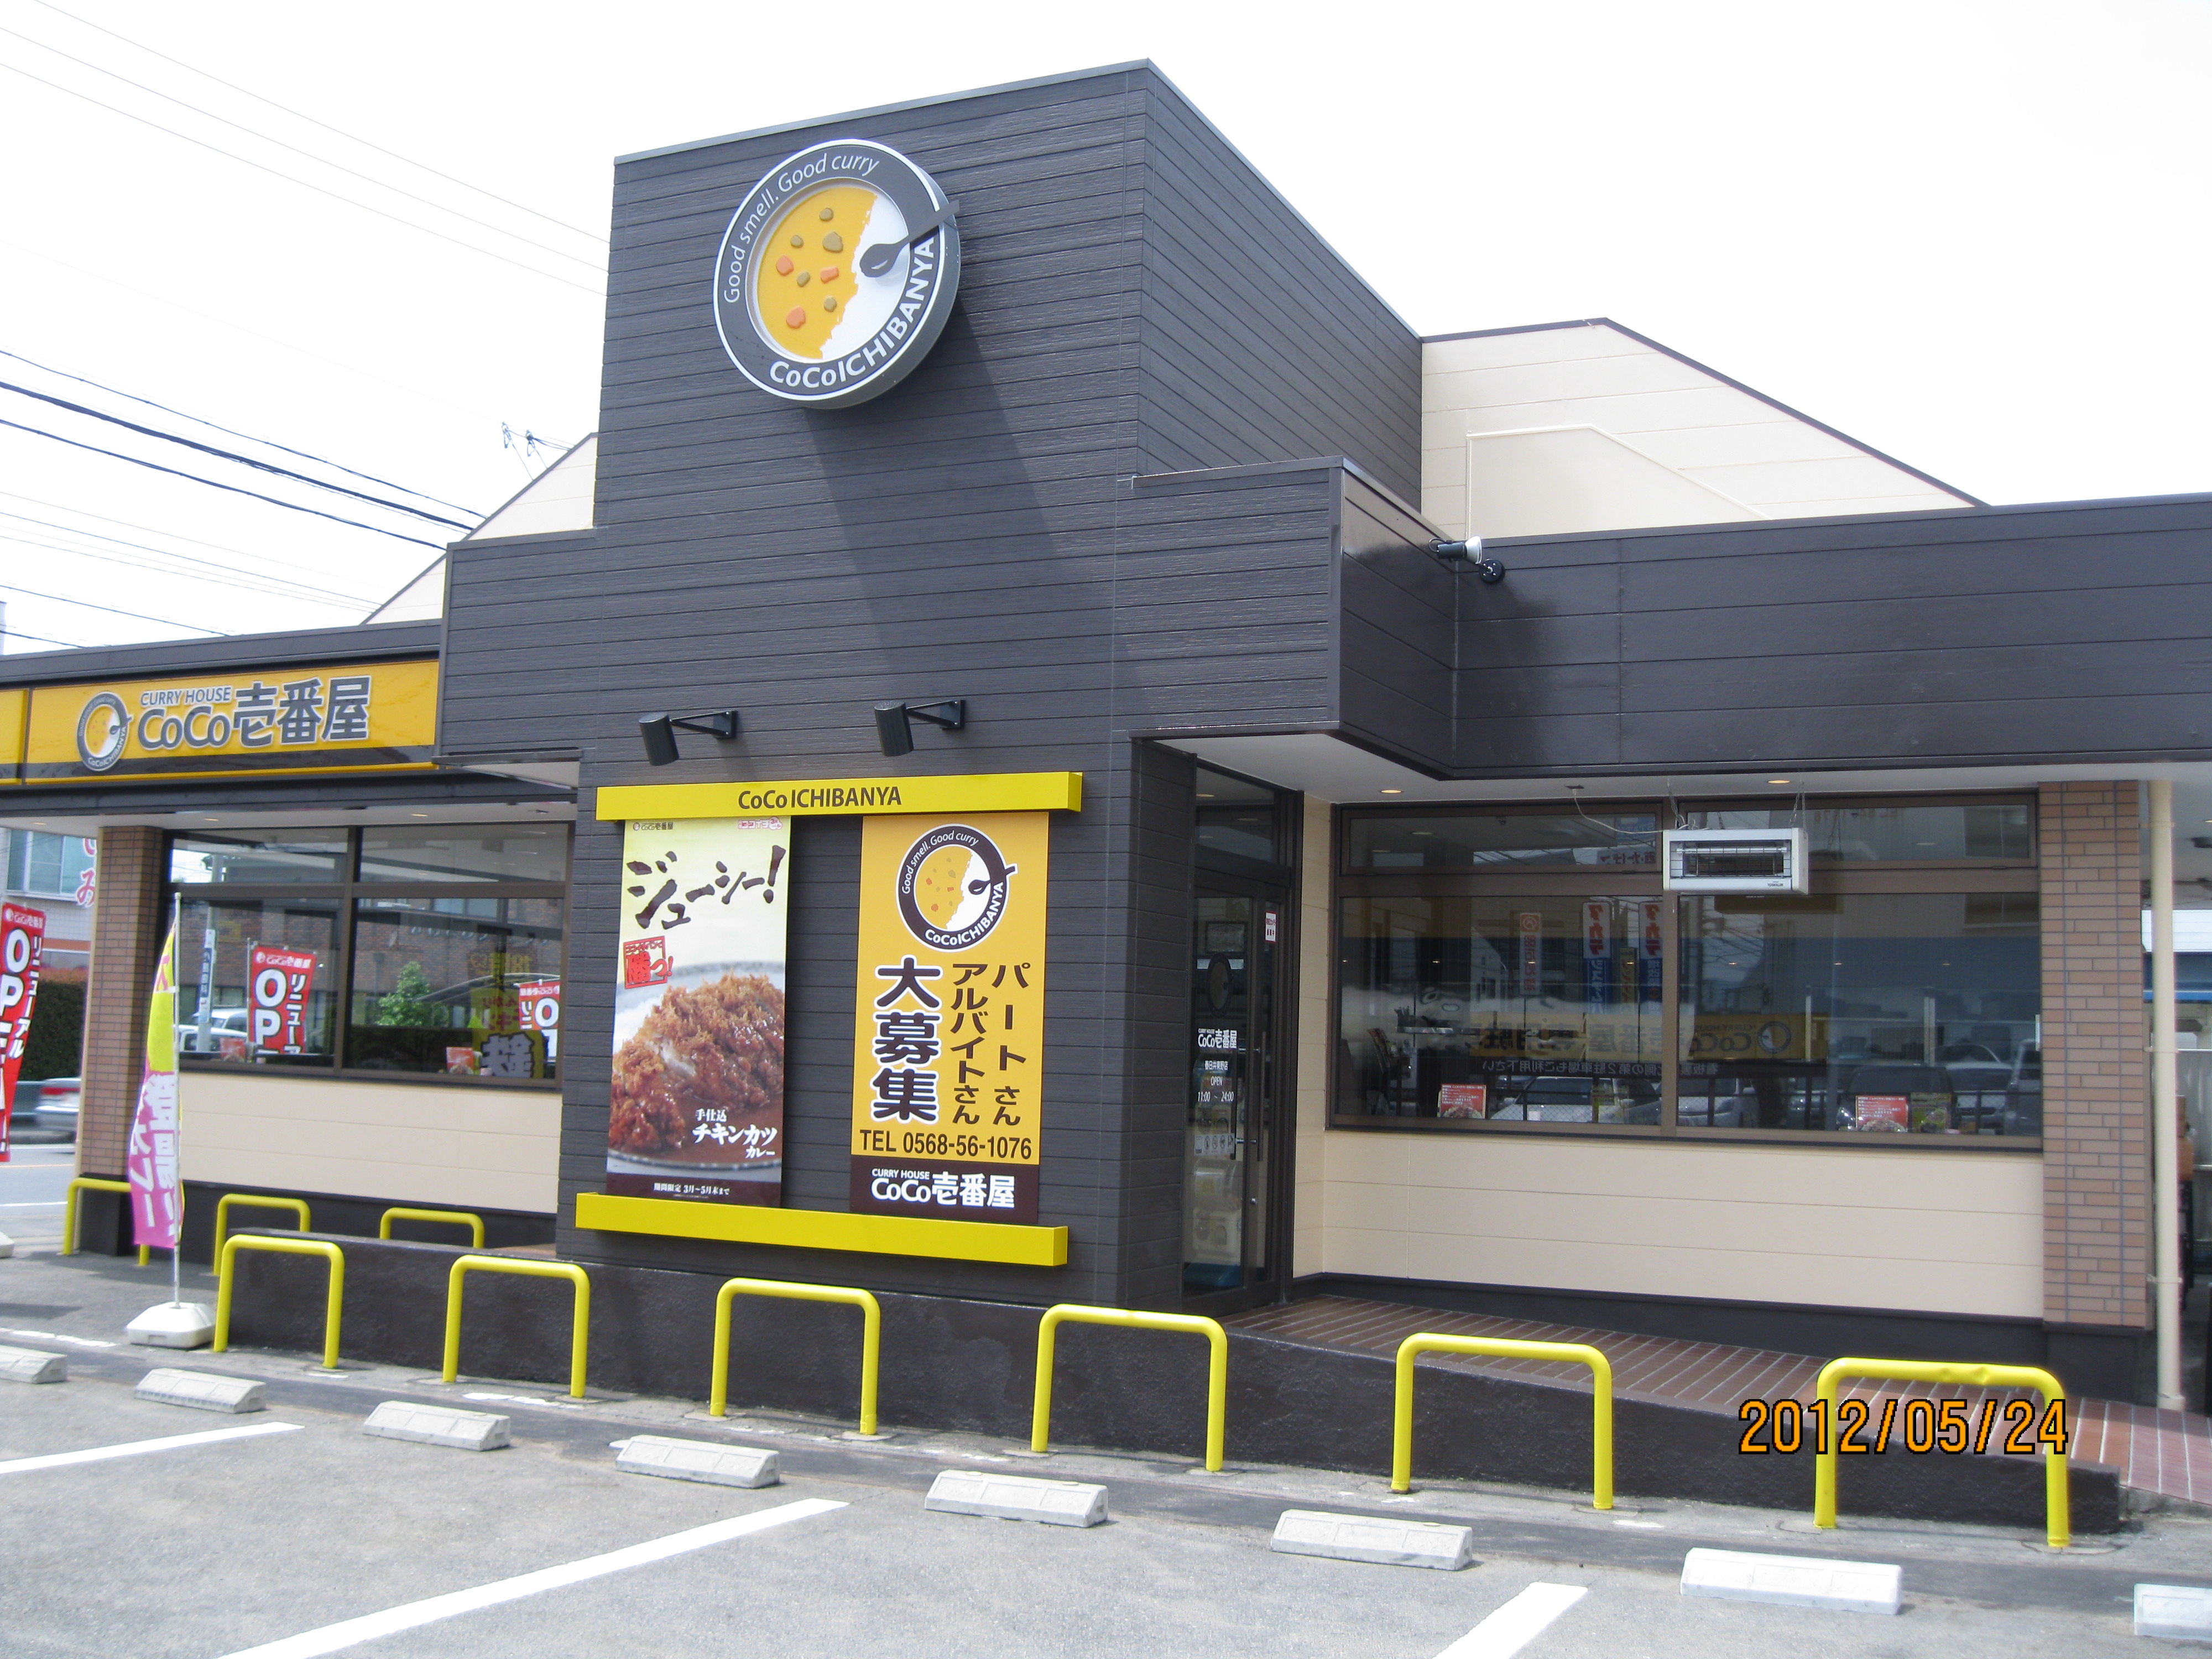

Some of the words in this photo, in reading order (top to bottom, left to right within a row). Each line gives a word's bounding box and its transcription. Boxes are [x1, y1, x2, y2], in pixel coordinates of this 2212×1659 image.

[724, 245, 745, 304] Good
[739, 188, 779, 245] smell.
[778, 153, 827, 194] Good
[831, 154, 880, 177] curry
[769, 238, 936, 388] CoCoICHIBANYA
[140, 688, 182, 707] CURRY
[185, 685, 232, 705] HOUSE
[902, 865, 914, 895] Good
[910, 840, 931, 868] smell.
[930, 830, 954, 846] Good
[955, 832, 979, 847] curry
[924, 881, 1004, 946] CoCoICHIBANYA
[8, 935, 43, 1060] リニューアル
[872, 956, 941, 1122] 大募集
[950, 963, 989, 1125] アルバイトさん
[992, 962, 1031, 1126] パートさん
[1198, 1091, 1211, 1102] 11:00
[1221, 1091, 1234, 1102] 24:00
[1211, 1076, 1223, 1086] OPEN
[692, 1122, 778, 1147] チキンカツ
[695, 1108, 727, 1123] 手仕込
[745, 1145, 776, 1159] カレー
[859, 1129, 897, 1152] TEL
[902, 1133, 1032, 1160] 0568-56-1076
[872, 1168, 899, 1178] CURRY
[900, 1170, 930, 1180] HOUSE
